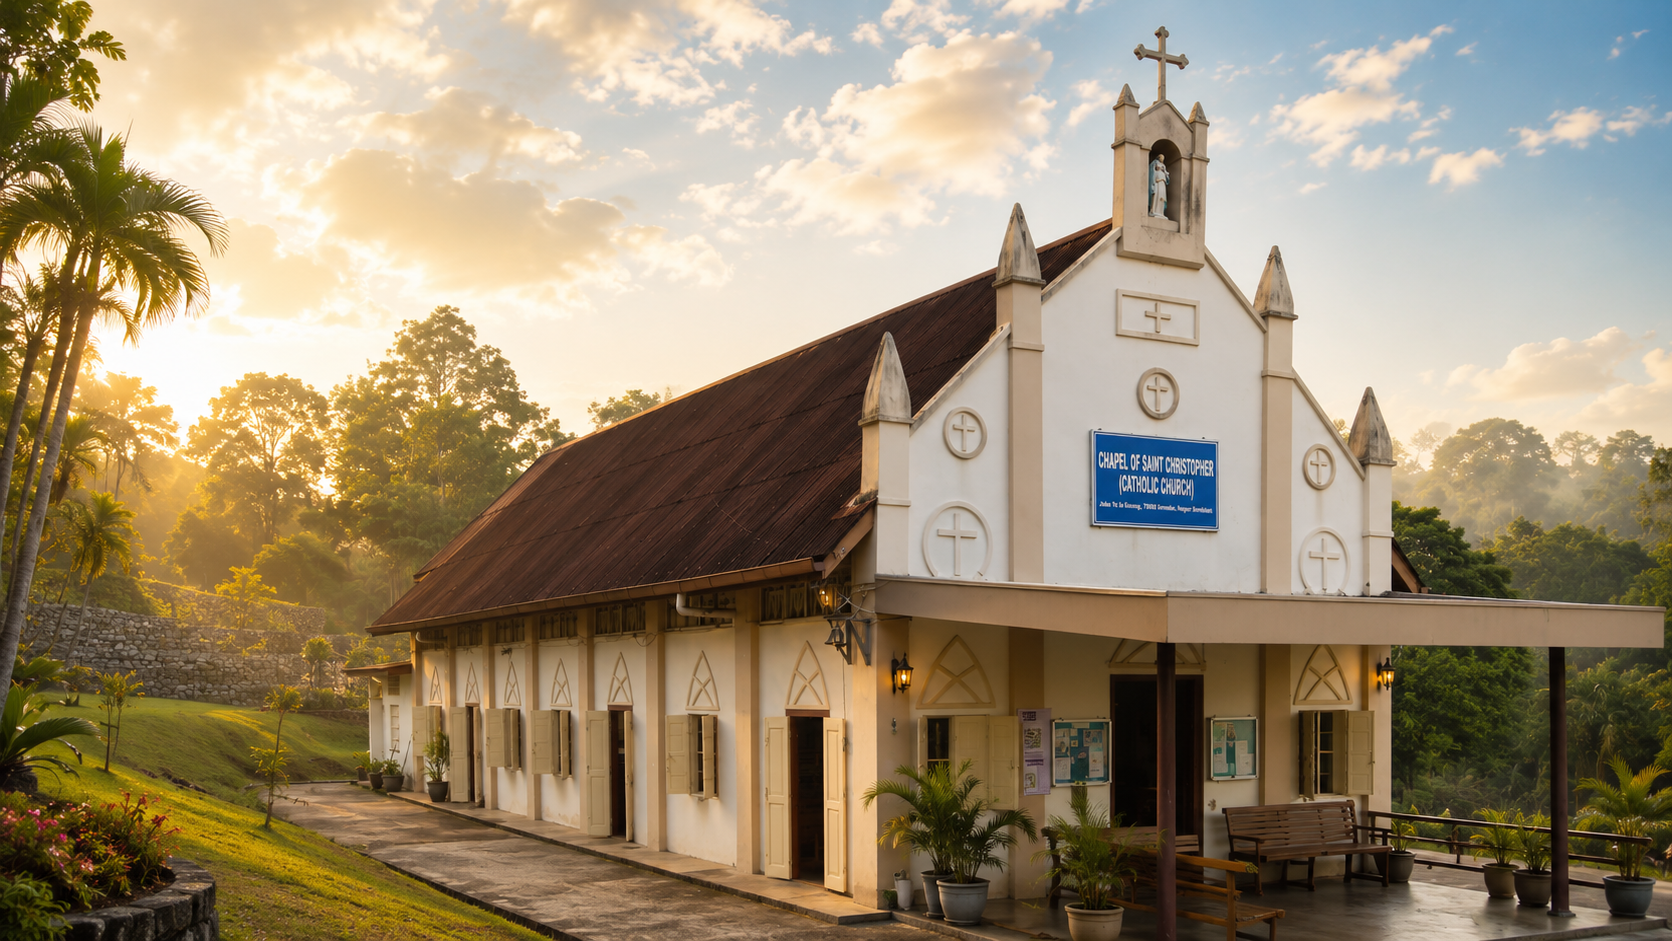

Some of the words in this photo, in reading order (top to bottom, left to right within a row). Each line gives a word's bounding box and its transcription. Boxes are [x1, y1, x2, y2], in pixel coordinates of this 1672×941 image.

[1099, 451, 1128, 470] CHAPEL
[1130, 454, 1140, 471] OF
[1142, 454, 1164, 473] SAINT
[1165, 457, 1214, 477] CHRISTOPHER
[1119, 474, 1159, 495] (CATHOLIC
[1160, 477, 1194, 501] CHURCH)
